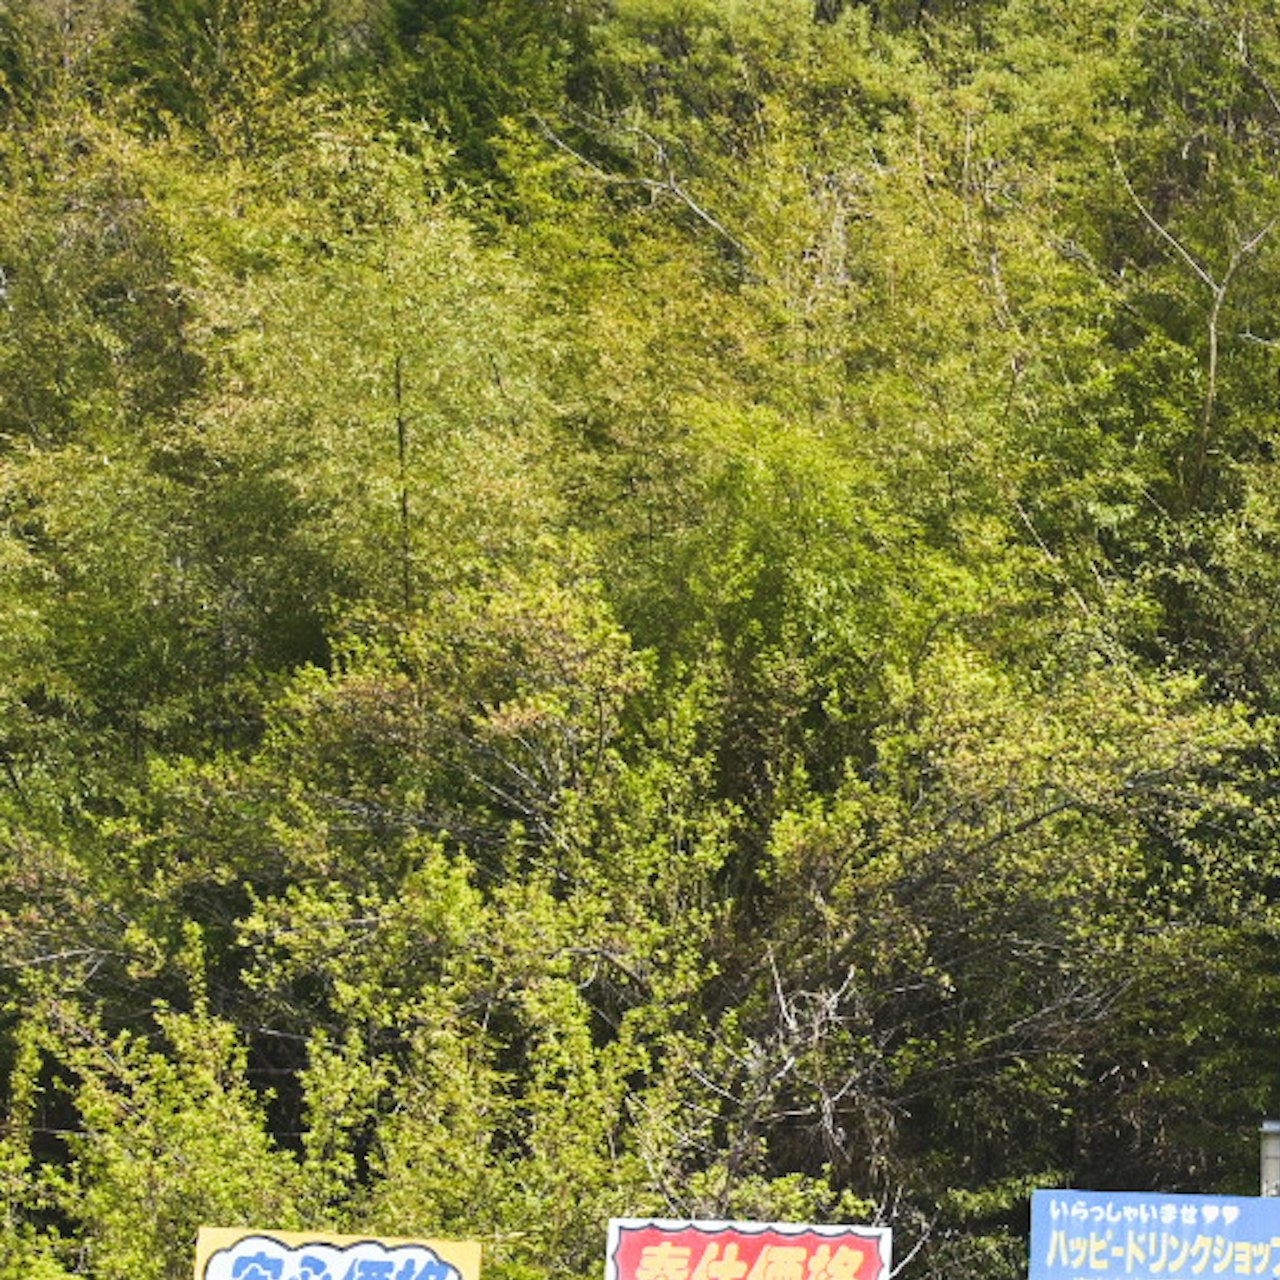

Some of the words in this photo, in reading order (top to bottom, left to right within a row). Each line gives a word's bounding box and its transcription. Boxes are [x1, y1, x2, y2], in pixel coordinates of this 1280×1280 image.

[1049, 1199, 1198, 1226] いらっしゃいませ
